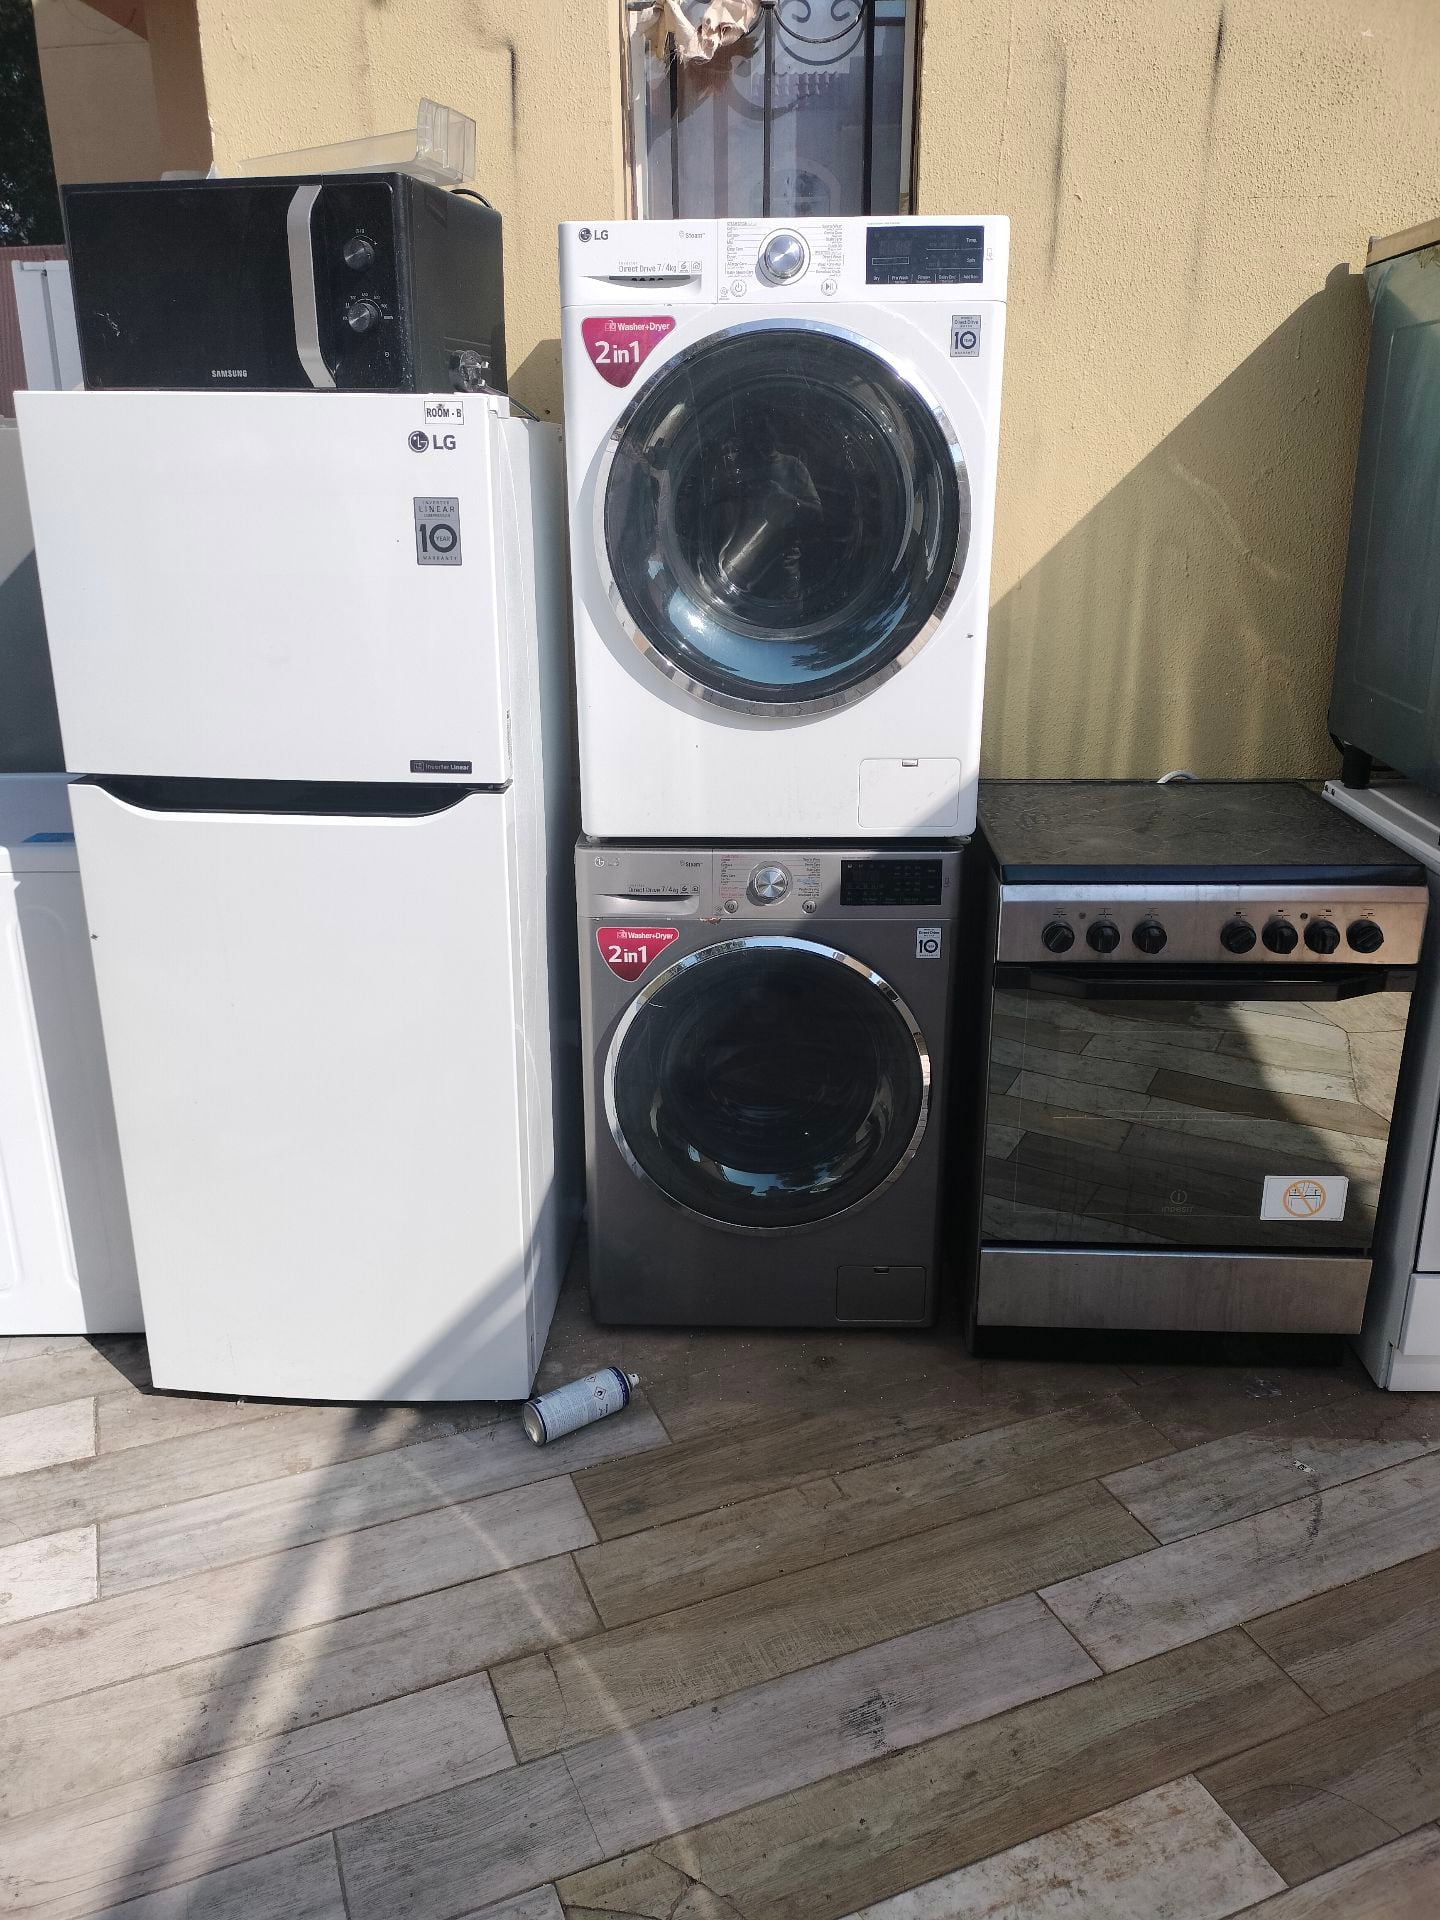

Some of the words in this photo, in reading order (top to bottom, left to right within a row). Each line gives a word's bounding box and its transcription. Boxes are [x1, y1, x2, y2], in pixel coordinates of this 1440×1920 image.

[593, 229, 609, 241] LG
[617, 322, 670, 332] Washer+Dryer
[954, 331, 977, 350] 10
[211, 369, 248, 378] SAMSUNG
[426, 408, 450, 418] ROOM
[456, 408, 462, 418] B
[432, 435, 457, 451] LG
[419, 523, 458, 553] 10
[627, 932, 673, 940] Washer+Dryer
[918, 939, 939, 954] 10
